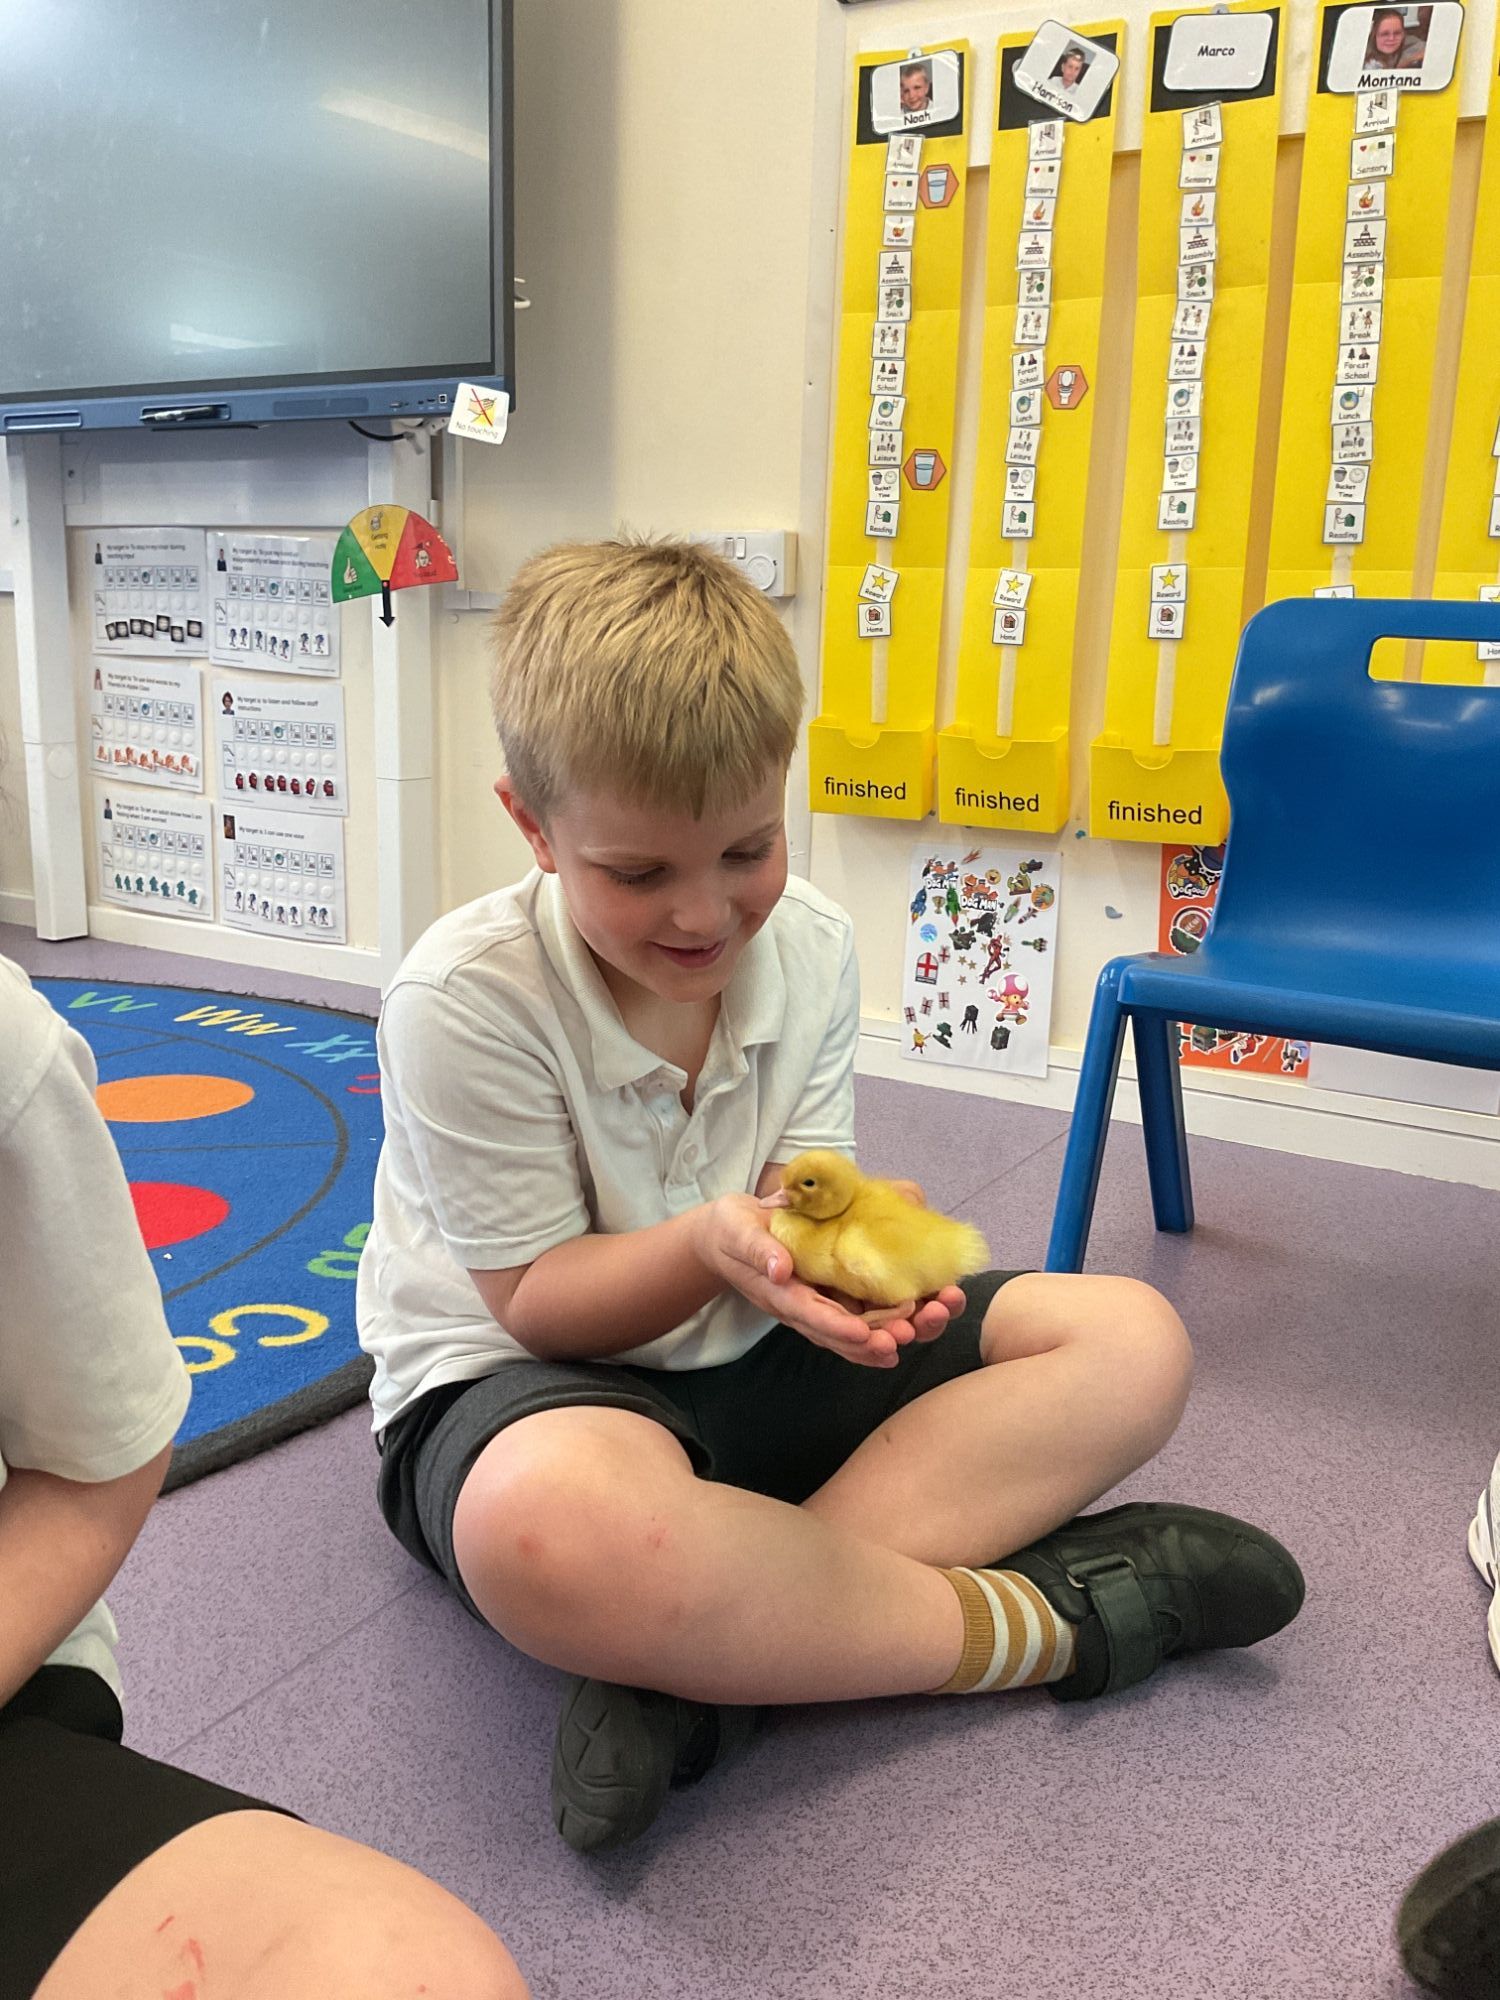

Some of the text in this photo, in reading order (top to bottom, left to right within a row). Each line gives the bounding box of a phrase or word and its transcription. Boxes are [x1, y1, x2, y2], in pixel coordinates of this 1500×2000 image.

[1198, 45, 1235, 57] Marco
[1357, 74, 1422, 88] Montana
[903, 113, 931, 126] Noah
[1347, 250, 1381, 259] Assembly
[1349, 331, 1371, 339] Break
[1344, 372, 1369, 380] School
[1338, 412, 1360, 420] Lunch
[1338, 451, 1367, 459] Leisure
[1328, 531, 1358, 540] Reading
[824, 777, 907, 800] finished
[955, 787, 1040, 812] finished
[1108, 801, 1202, 825] finished
[962, 896, 997, 911] DOG MAN
